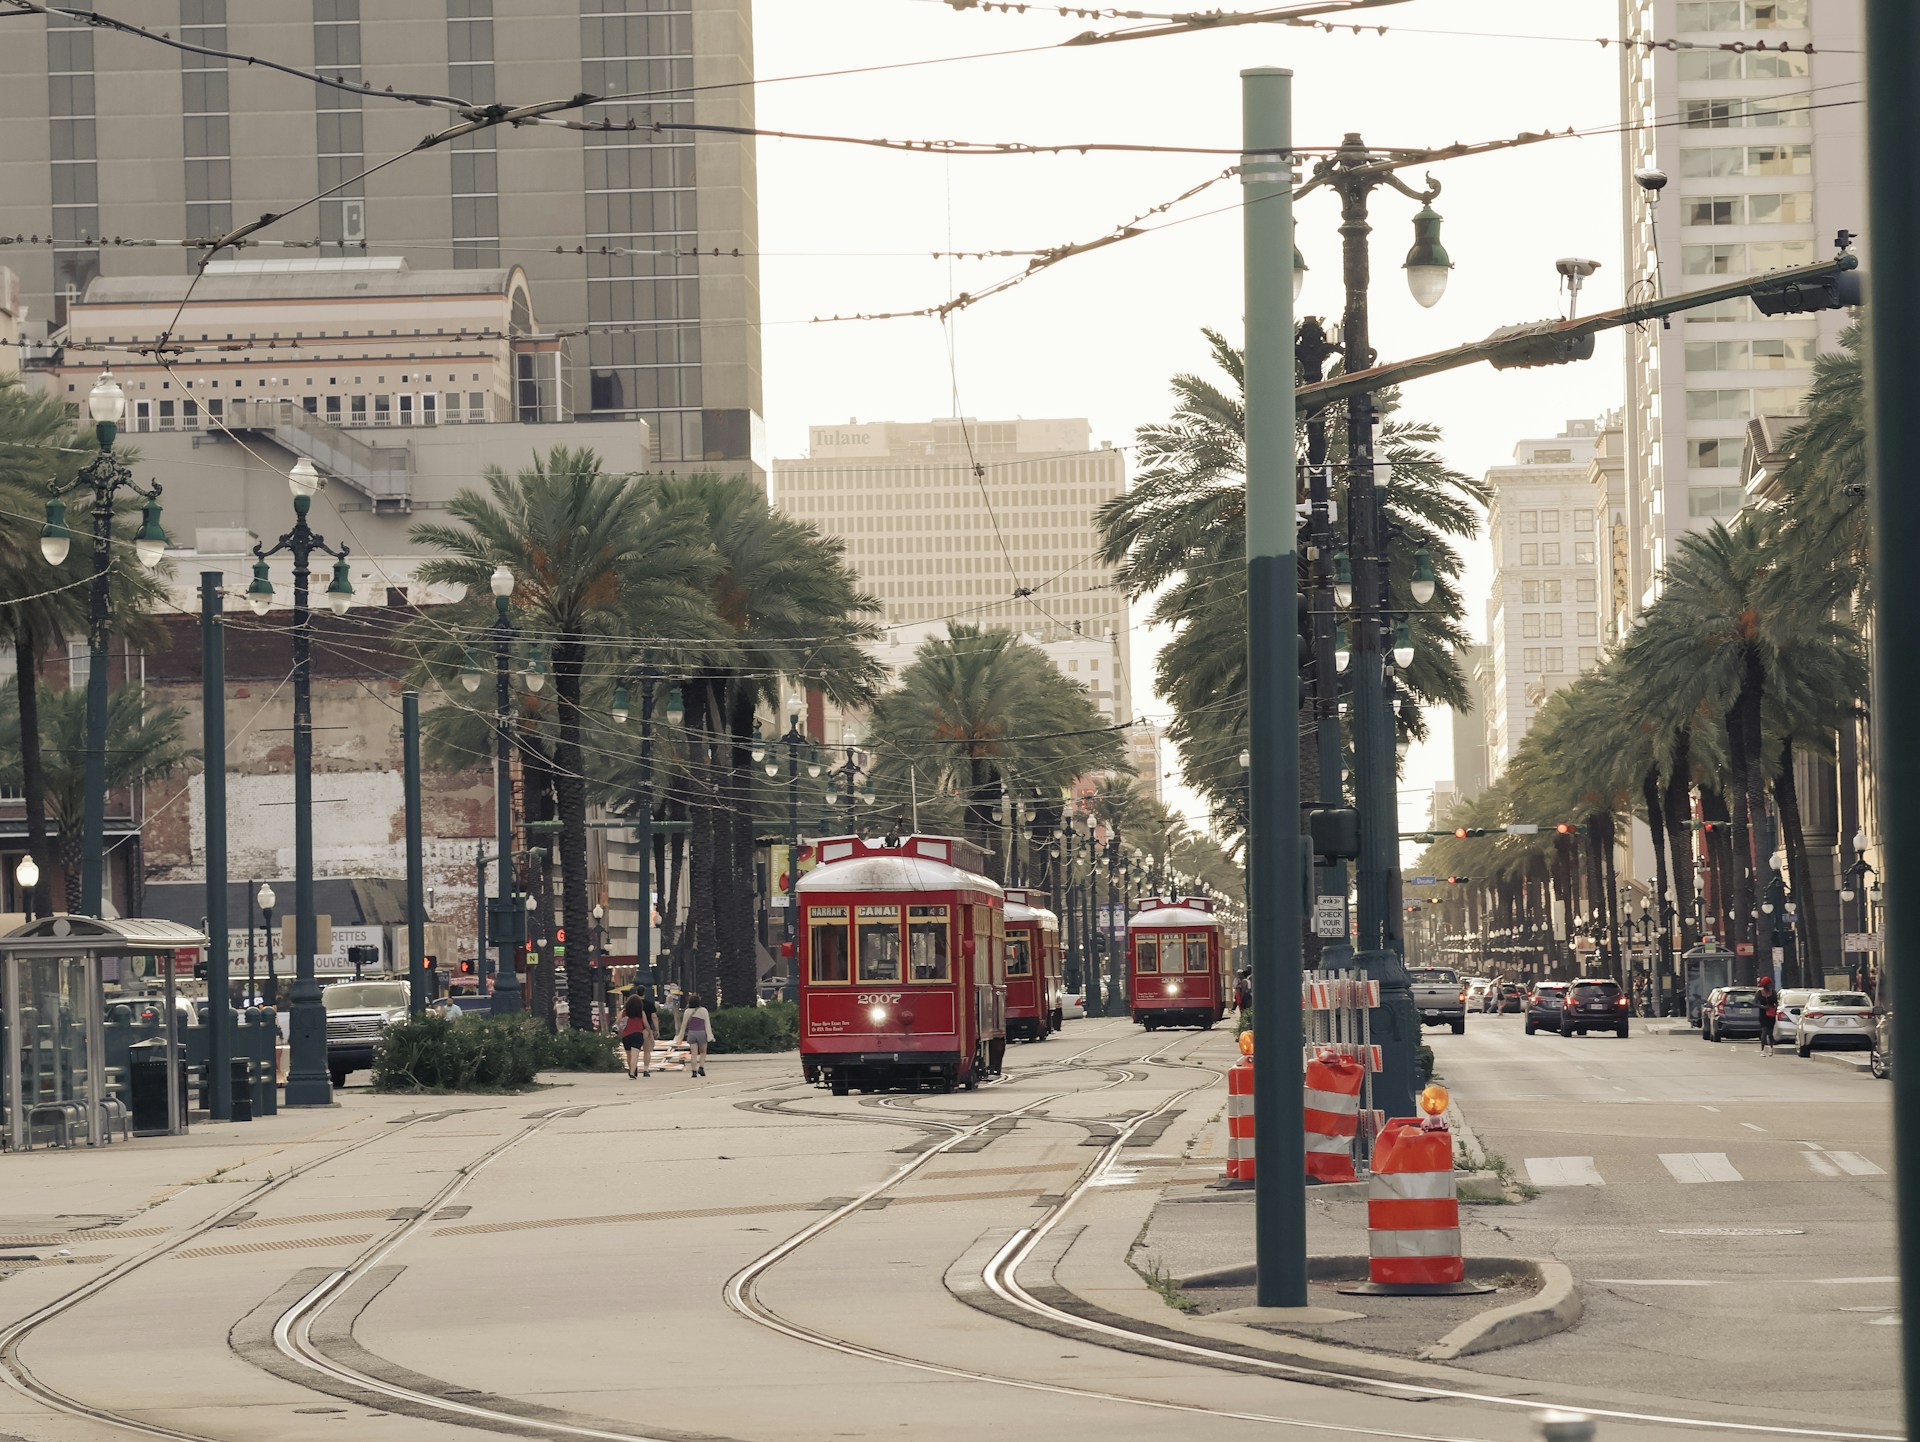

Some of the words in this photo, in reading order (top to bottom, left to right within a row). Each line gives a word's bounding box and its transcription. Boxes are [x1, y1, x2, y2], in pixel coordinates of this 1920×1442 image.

[814, 431, 870, 446] Tulane
[858, 906, 898, 916] CANAL
[331, 931, 367, 942] RETTES
[858, 994, 902, 1004] 2007
